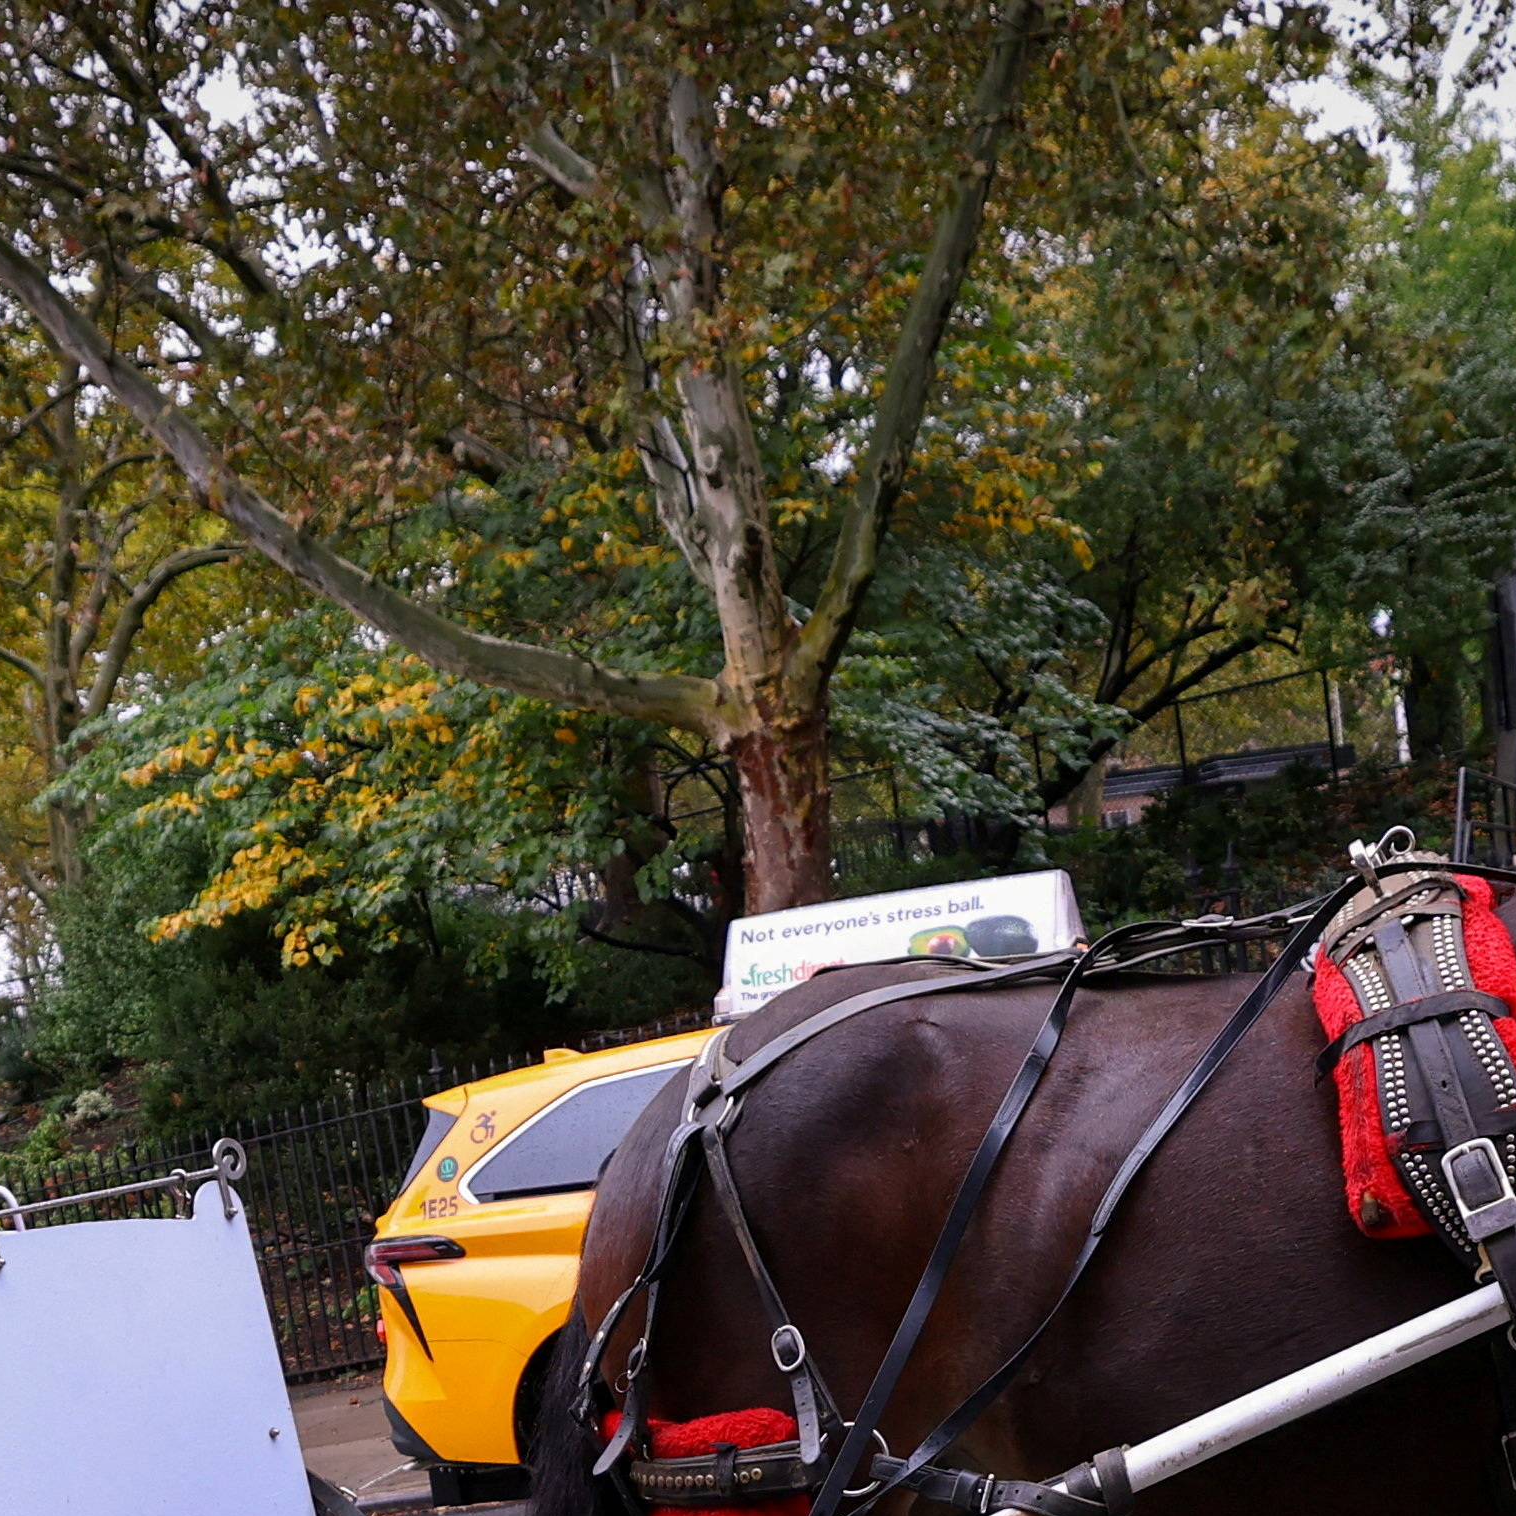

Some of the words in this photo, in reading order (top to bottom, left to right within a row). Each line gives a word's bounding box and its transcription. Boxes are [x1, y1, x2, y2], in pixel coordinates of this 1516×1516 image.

[740, 929, 775, 945] Not
[781, 911, 882, 939] everyone's
[886, 902, 943, 923] stress
[948, 895, 985, 915] ball.
[741, 991, 759, 1001] The
[419, 1195, 459, 1221] 1E25
